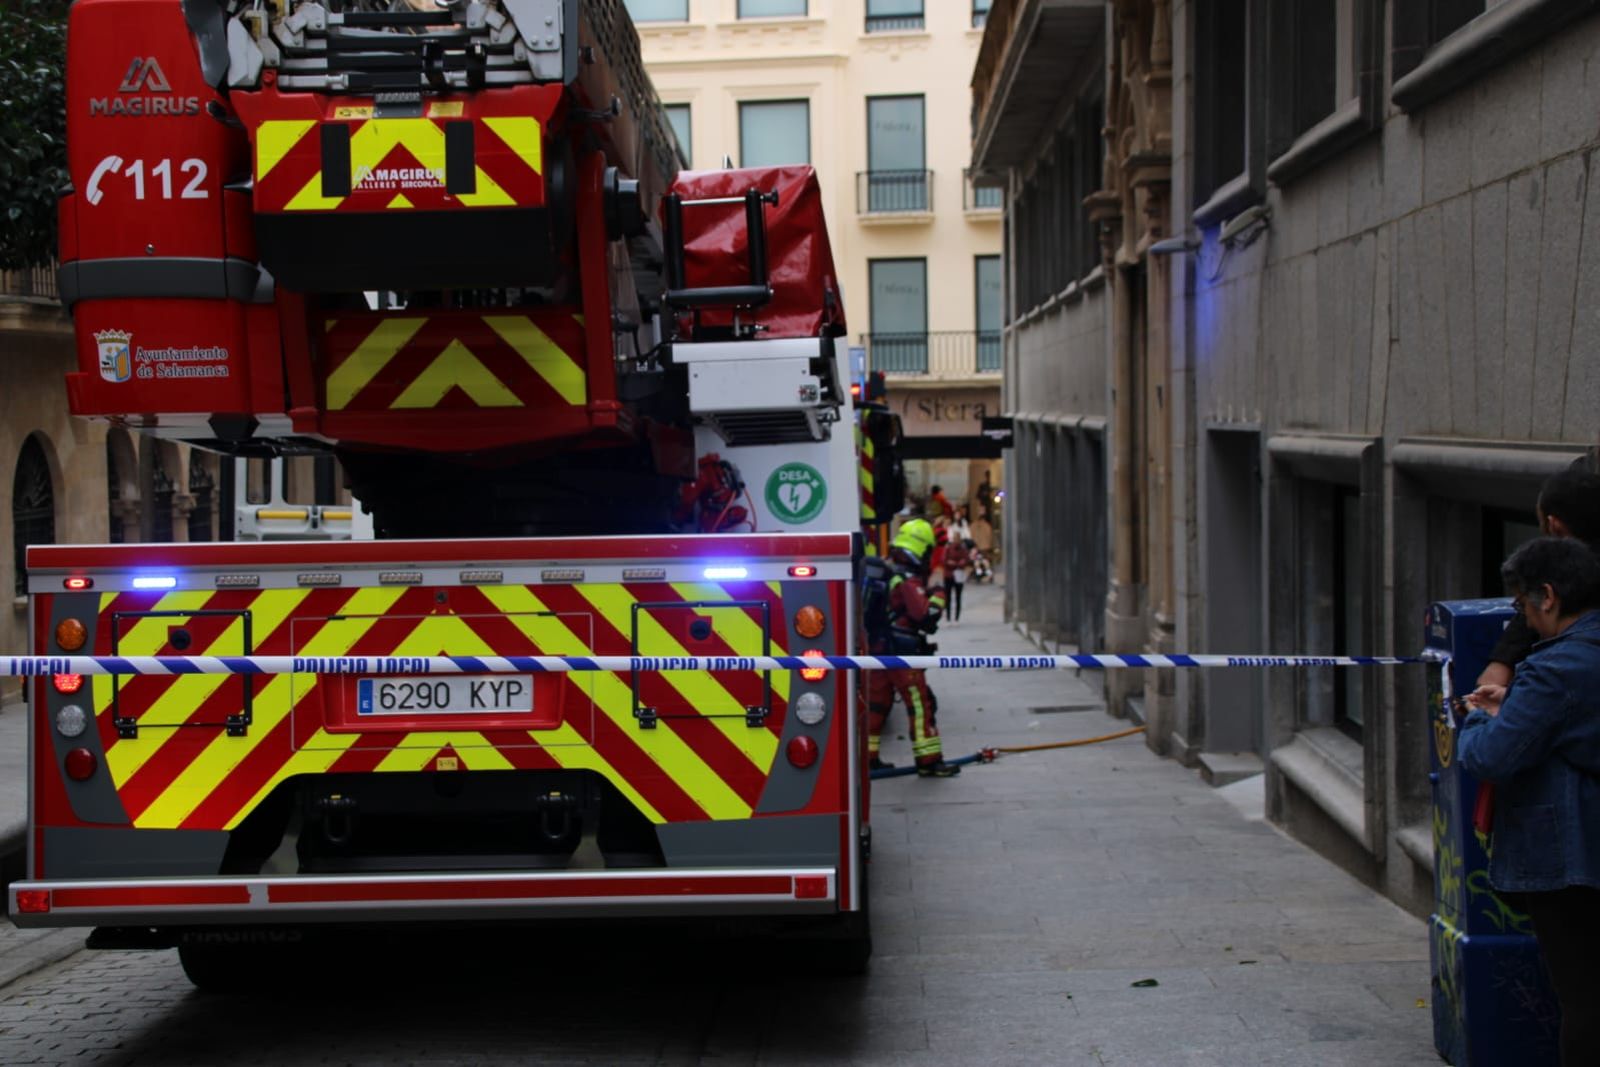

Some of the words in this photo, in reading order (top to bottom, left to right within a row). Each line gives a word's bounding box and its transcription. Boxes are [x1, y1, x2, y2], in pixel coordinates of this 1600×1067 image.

[90, 97, 200, 116] MAGIRUS
[125, 158, 209, 200] 112
[376, 168, 445, 181] MAGIRUS
[352, 181, 396, 189] ALLERES
[136, 346, 228, 364] Ayuntamiento
[136, 363, 153, 378] de
[156, 363, 229, 378] Salamanca
[779, 470, 811, 481] DESA
[293, 658, 368, 673] POLICIA
[379, 682, 450, 710] 6290
[470, 680, 523, 708] KYP
